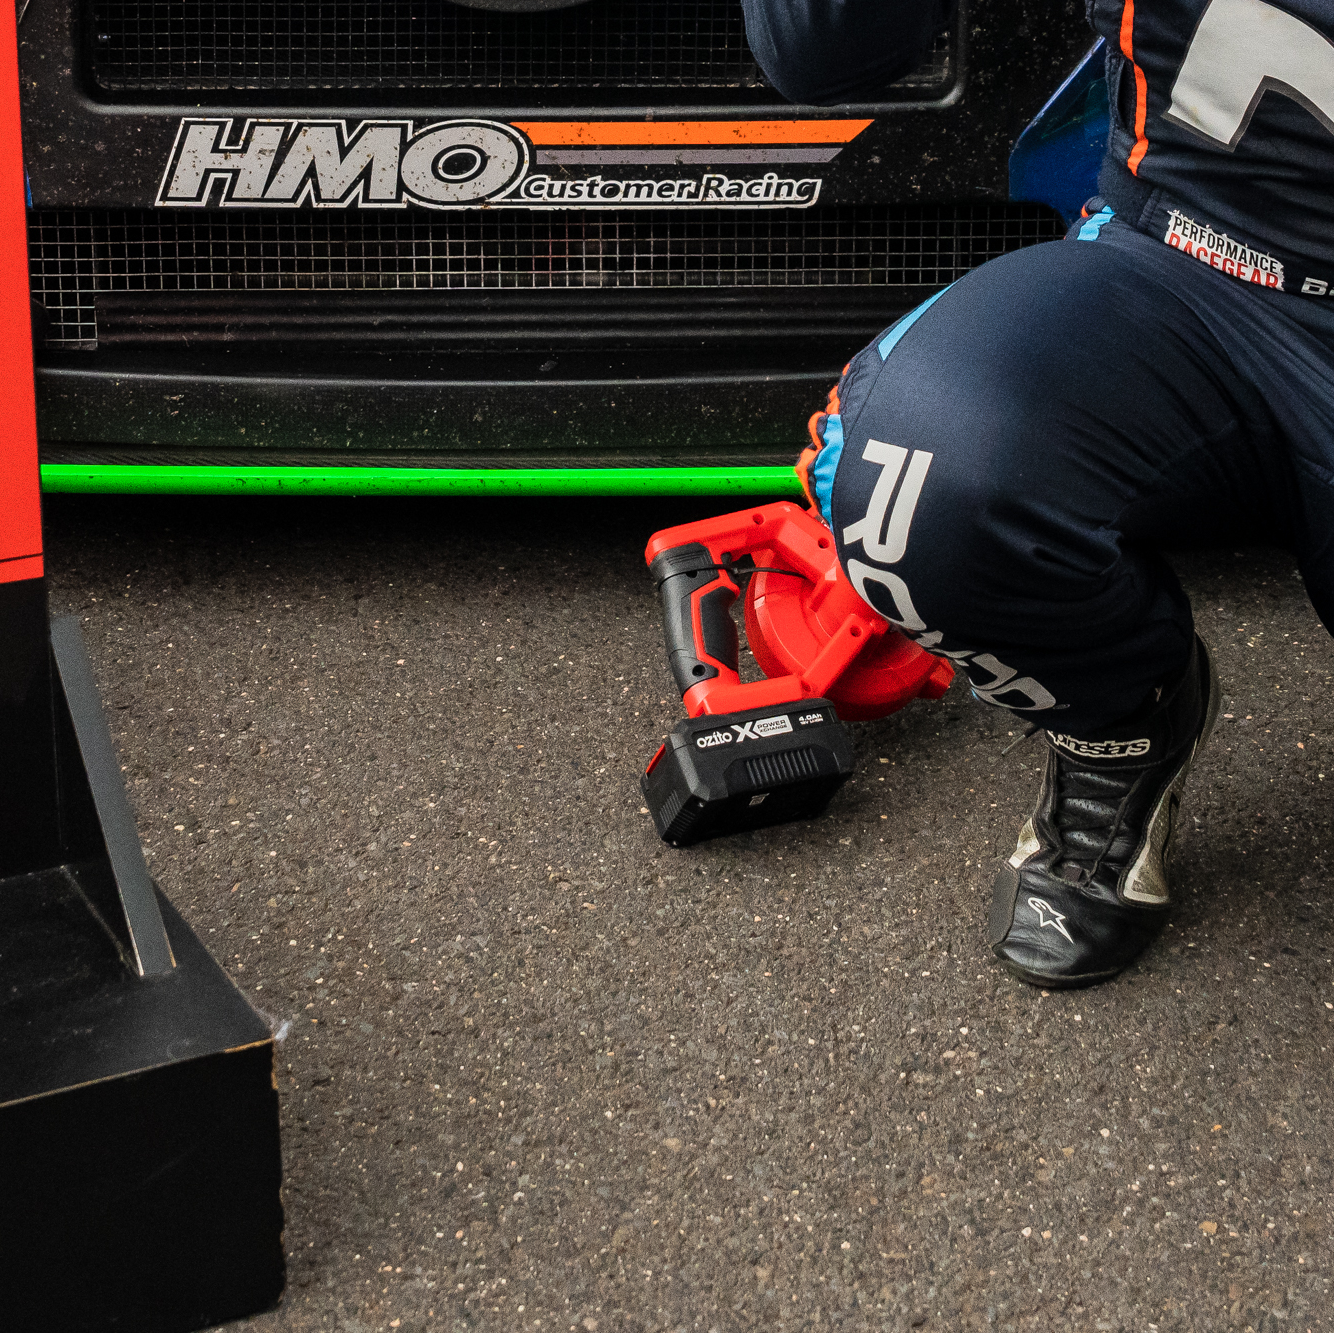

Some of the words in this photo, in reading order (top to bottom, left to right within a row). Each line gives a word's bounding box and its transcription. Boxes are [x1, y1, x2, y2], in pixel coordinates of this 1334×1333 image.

[155, 118, 530, 209] HMO
[522, 174, 699, 204] Customer
[703, 174, 821, 207] Racing
[1172, 215, 1279, 274] PERFORMANCE
[757, 719, 786, 730] POWER
[798, 712, 823, 723] 4.0Ah
[697, 731, 732, 748] ozito
